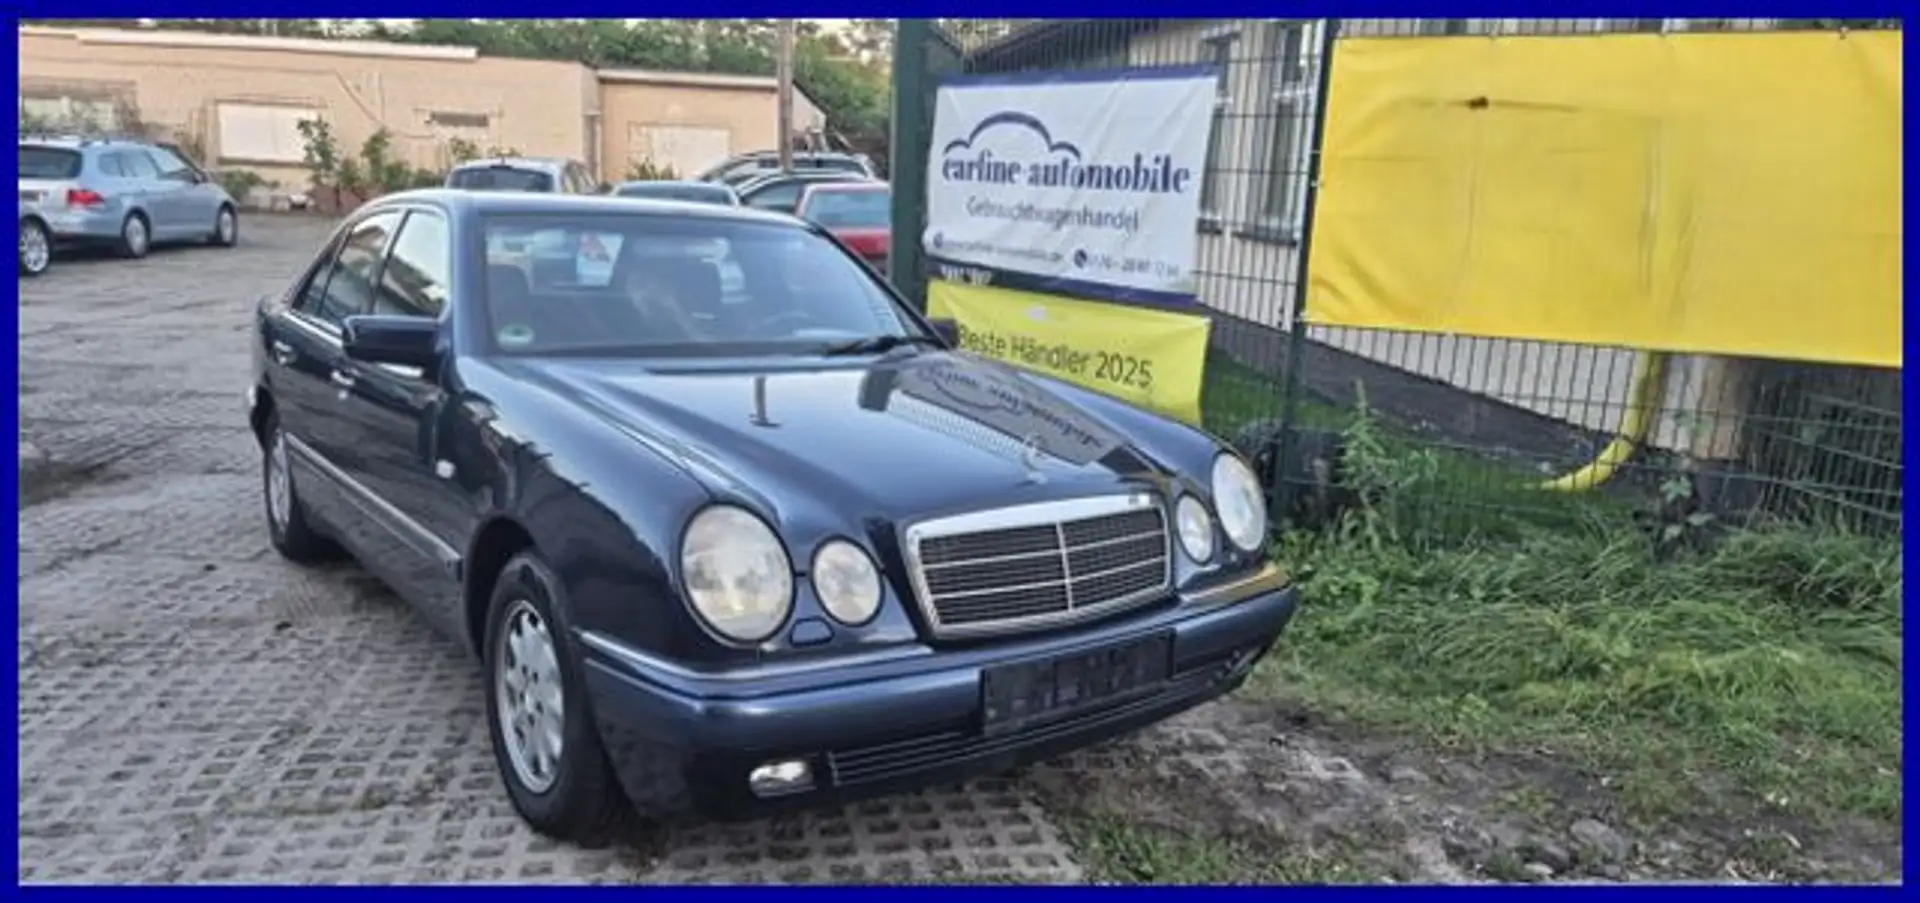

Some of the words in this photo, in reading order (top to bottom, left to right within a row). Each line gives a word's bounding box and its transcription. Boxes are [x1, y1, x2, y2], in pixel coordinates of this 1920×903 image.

[1027, 151, 1190, 194] automobile
[959, 324, 1007, 357] Beste
[1010, 336, 1090, 375] Händler
[1094, 350, 1154, 388] 2025
